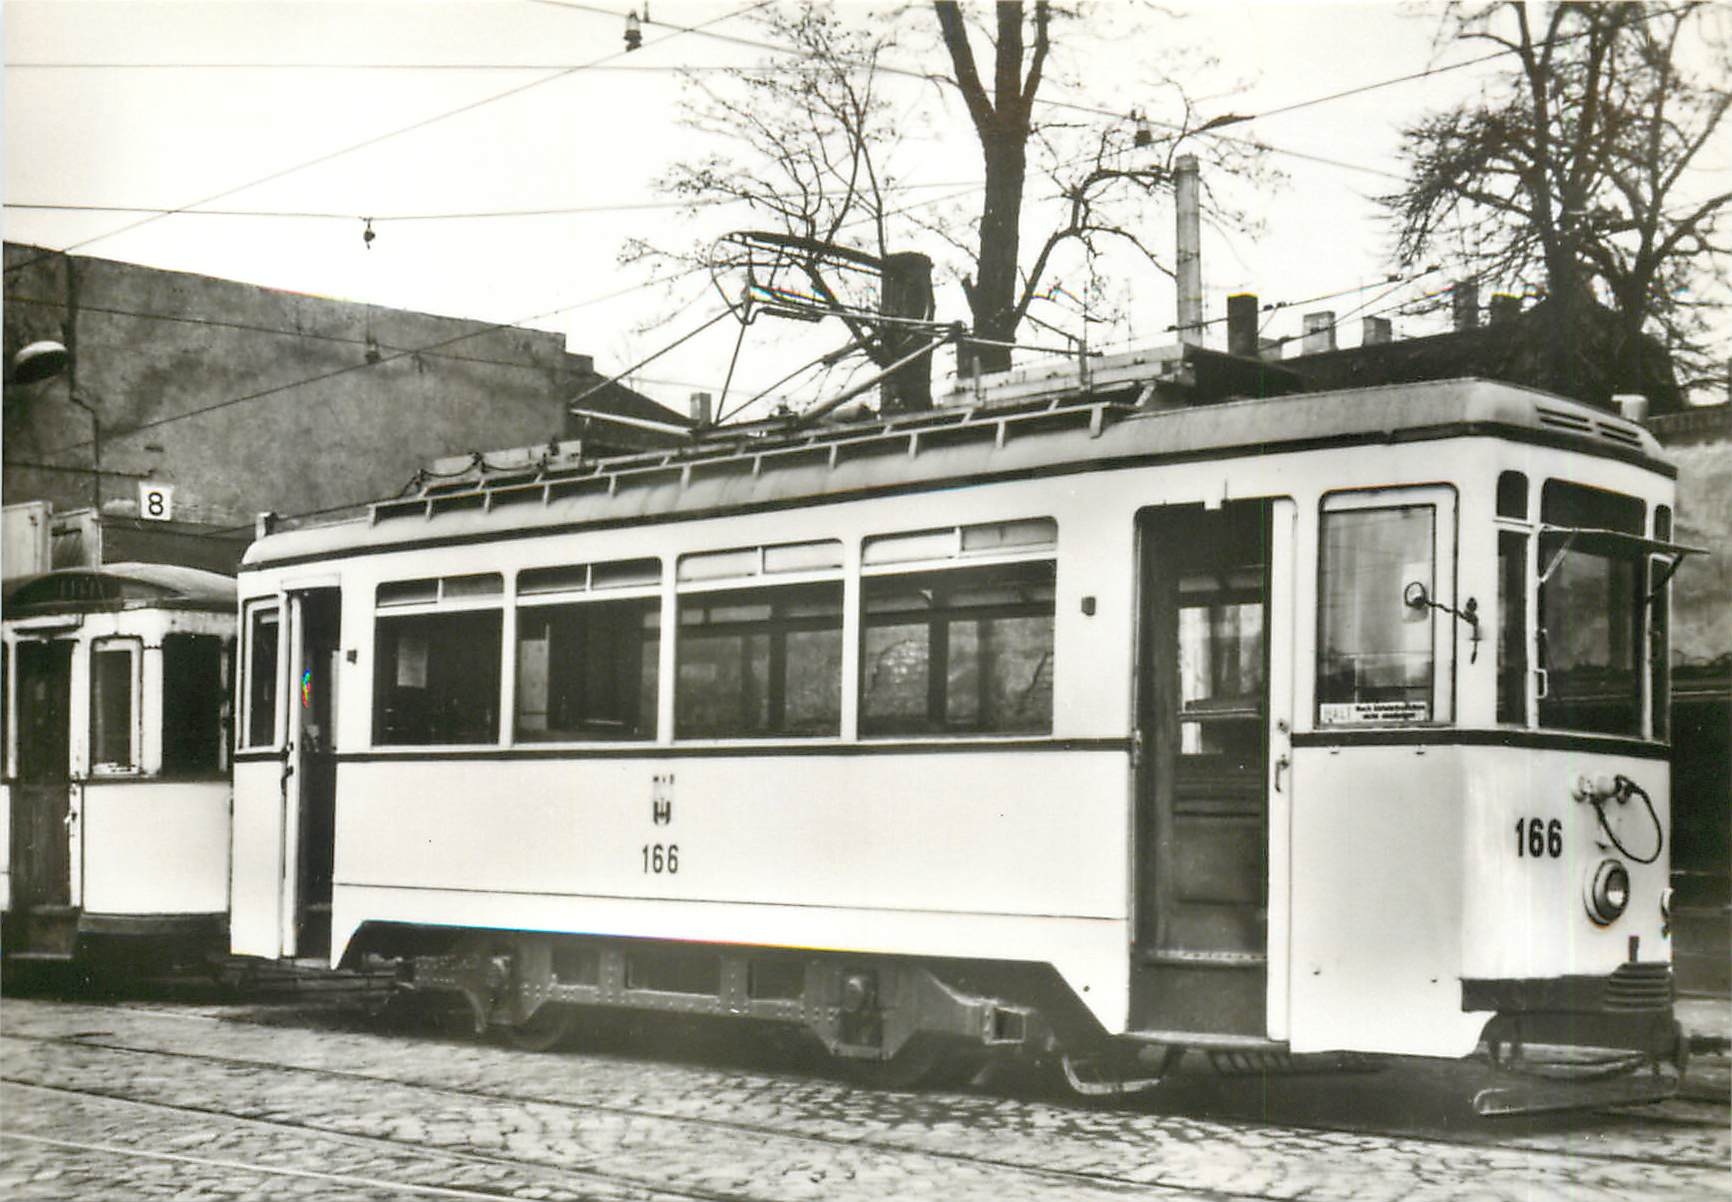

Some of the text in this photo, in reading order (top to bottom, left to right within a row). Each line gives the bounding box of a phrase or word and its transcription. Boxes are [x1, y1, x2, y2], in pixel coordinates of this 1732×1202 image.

[148, 492, 164, 517] 8
[1515, 817, 1562, 859] 166
[642, 843, 679, 875] 166
